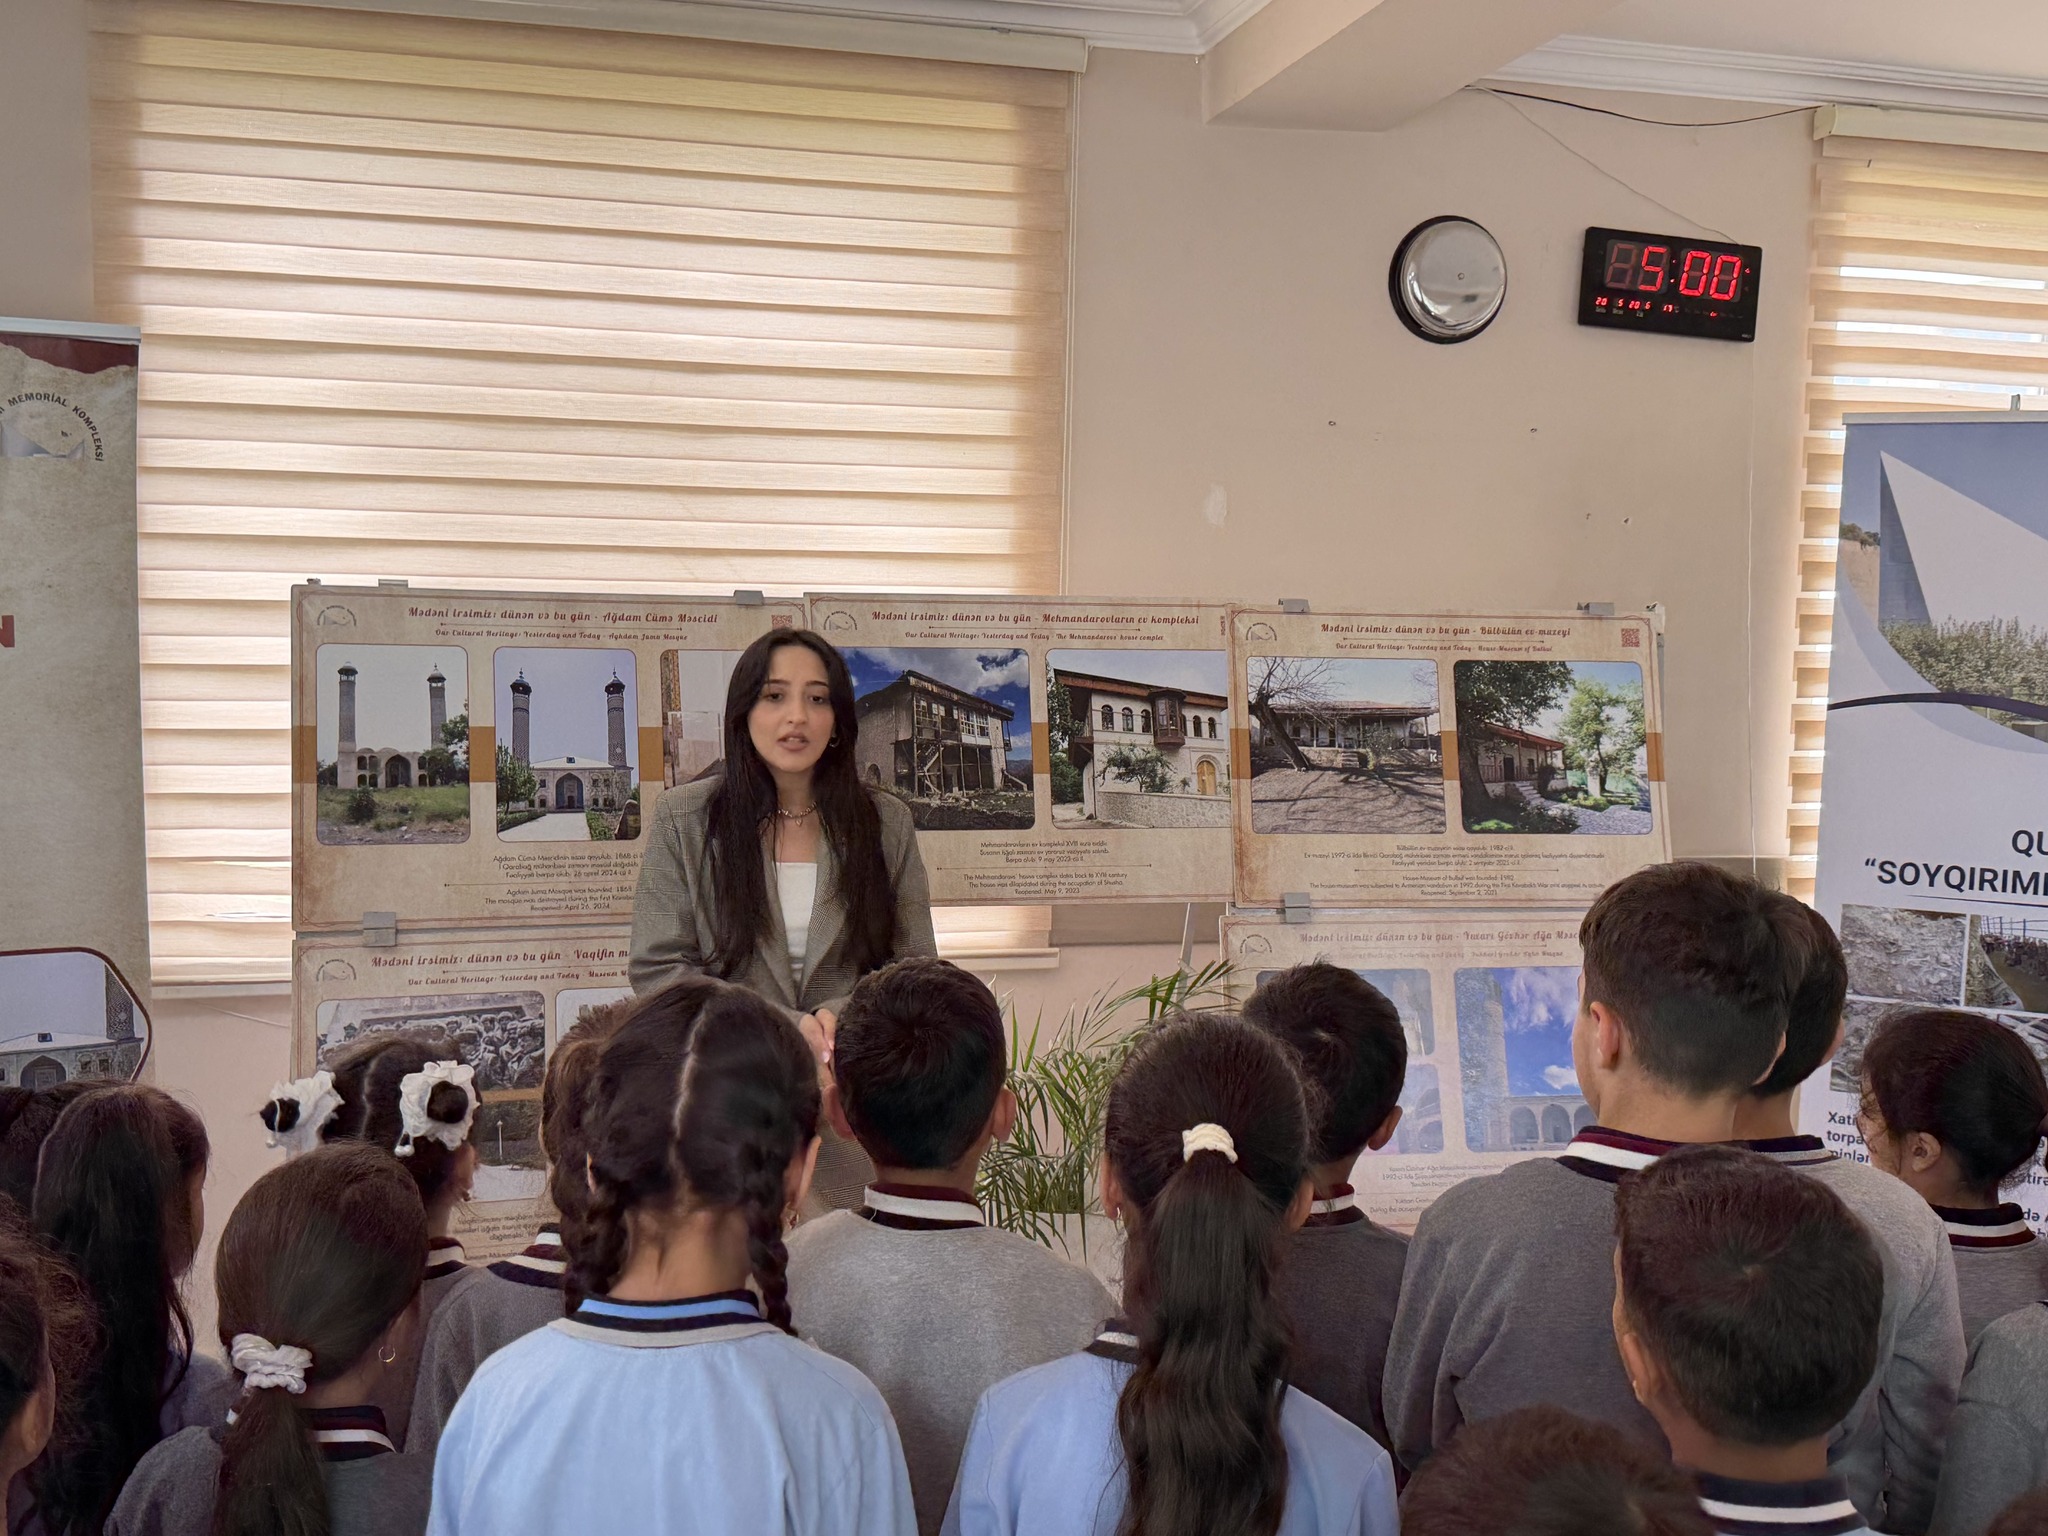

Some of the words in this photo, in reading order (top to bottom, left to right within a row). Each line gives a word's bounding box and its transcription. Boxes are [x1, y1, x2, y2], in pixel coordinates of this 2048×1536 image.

[408, 607, 449, 617] Mədəni
[500, 609, 534, 620] dünən
[553, 611, 567, 621] bu
[570, 612, 591, 623] gün
[602, 612, 641, 624] Ağdam
[645, 612, 673, 623] Cümə
[677, 613, 718, 623] Məscidi
[871, 611, 907, 621] Mədəni
[952, 612, 982, 622] dünən
[998, 613, 1010, 622] bu
[1013, 613, 1032, 624] gün
[1042, 613, 1135, 624] Mehmandarovların
[1151, 614, 1199, 626] kompleksi
[580, 632, 601, 640] Today
[1321, 623, 1353, 633] Mədəni
[1395, 625, 1423, 634] dünən
[1438, 626, 1450, 634] bu
[1452, 627, 1470, 636] gün
[1480, 626, 1522, 635] Bülbülün
[467, 953, 502, 964] dünən
[506, 954, 519, 962] və
[523, 952, 536, 961] bu
[540, 950, 561, 963] gün
